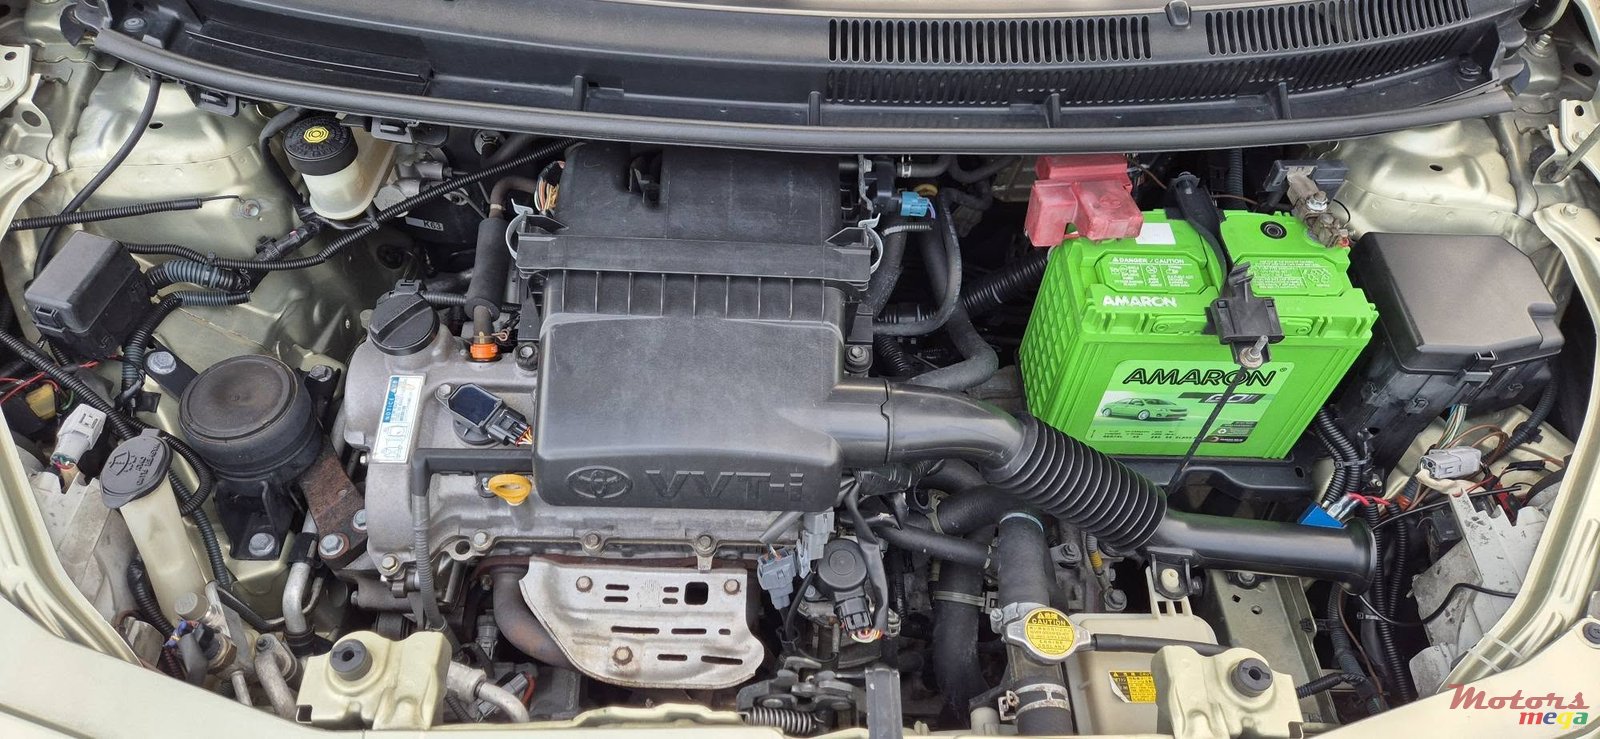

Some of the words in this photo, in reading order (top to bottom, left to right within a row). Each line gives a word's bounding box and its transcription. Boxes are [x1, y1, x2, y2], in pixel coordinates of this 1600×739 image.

[1102, 295, 1178, 308] AMARON
[1122, 367, 1277, 387] AMARON
[645, 469, 804, 501] VVT-i
[1031, 618, 1066, 626] CAUTION
